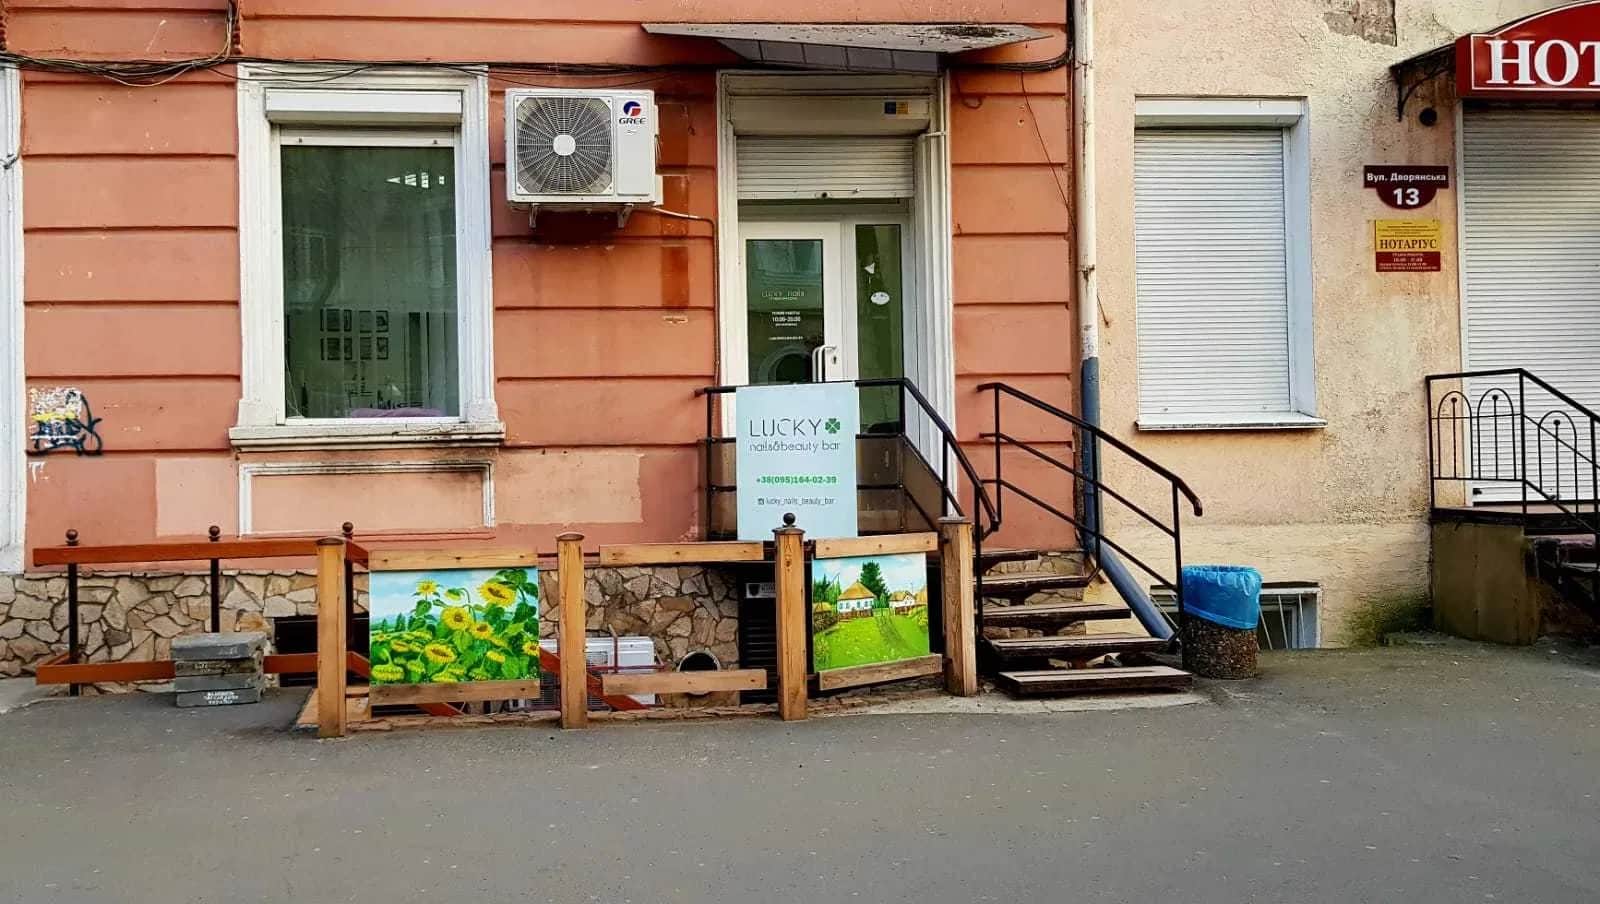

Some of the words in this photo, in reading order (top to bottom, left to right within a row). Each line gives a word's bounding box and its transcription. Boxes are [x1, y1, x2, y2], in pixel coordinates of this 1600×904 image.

[1367, 172, 1388, 183] Вул.
[1390, 172, 1447, 183] Дворянська
[1393, 188, 1420, 206] 13
[1380, 239, 1437, 250] НОТАРІУС
[750, 418, 822, 437] LUCKY
[750, 441, 818, 453] nails&beauty
[822, 439, 840, 450] bar
